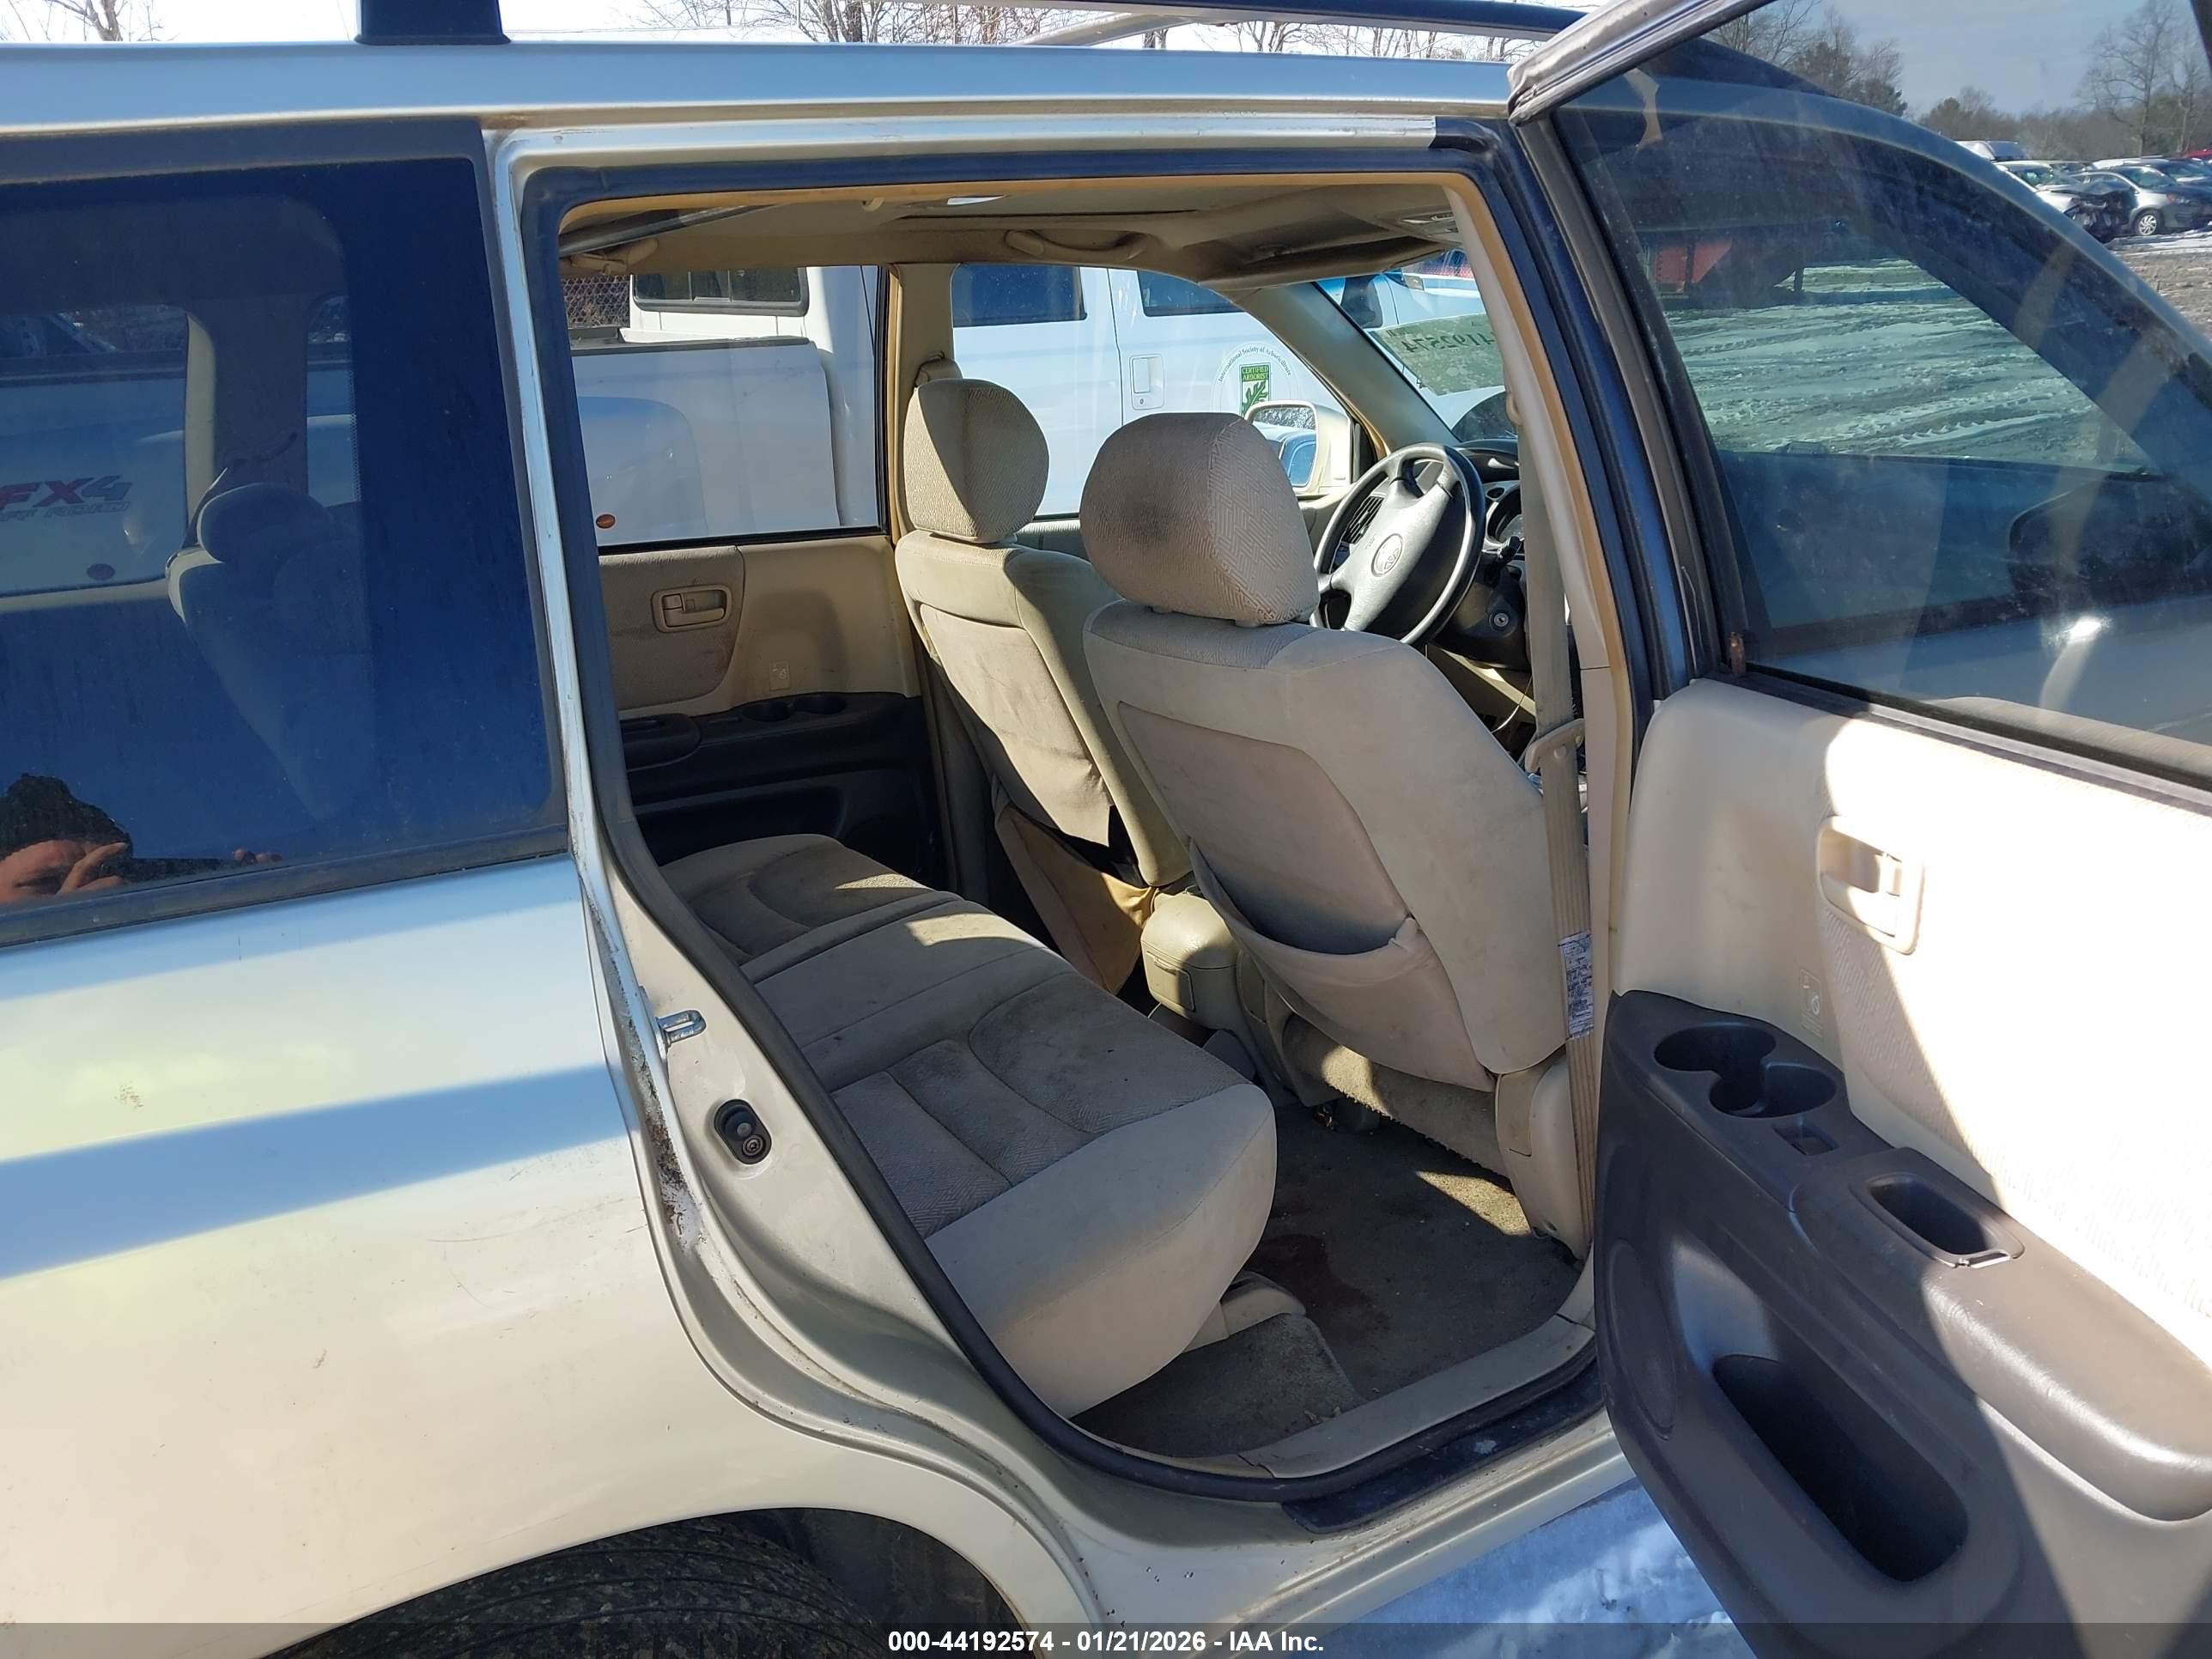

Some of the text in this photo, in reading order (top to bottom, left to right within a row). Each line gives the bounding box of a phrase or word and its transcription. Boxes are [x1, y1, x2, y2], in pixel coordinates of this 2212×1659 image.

[1218, 350, 1242, 382] International
[1242, 346, 1259, 356] Society
[1259, 345, 1266, 354] of
[1242, 366, 1268, 374] CERTIFIED
[1243, 373, 1268, 381] ARBORIST
[0, 475, 133, 511] FX4
